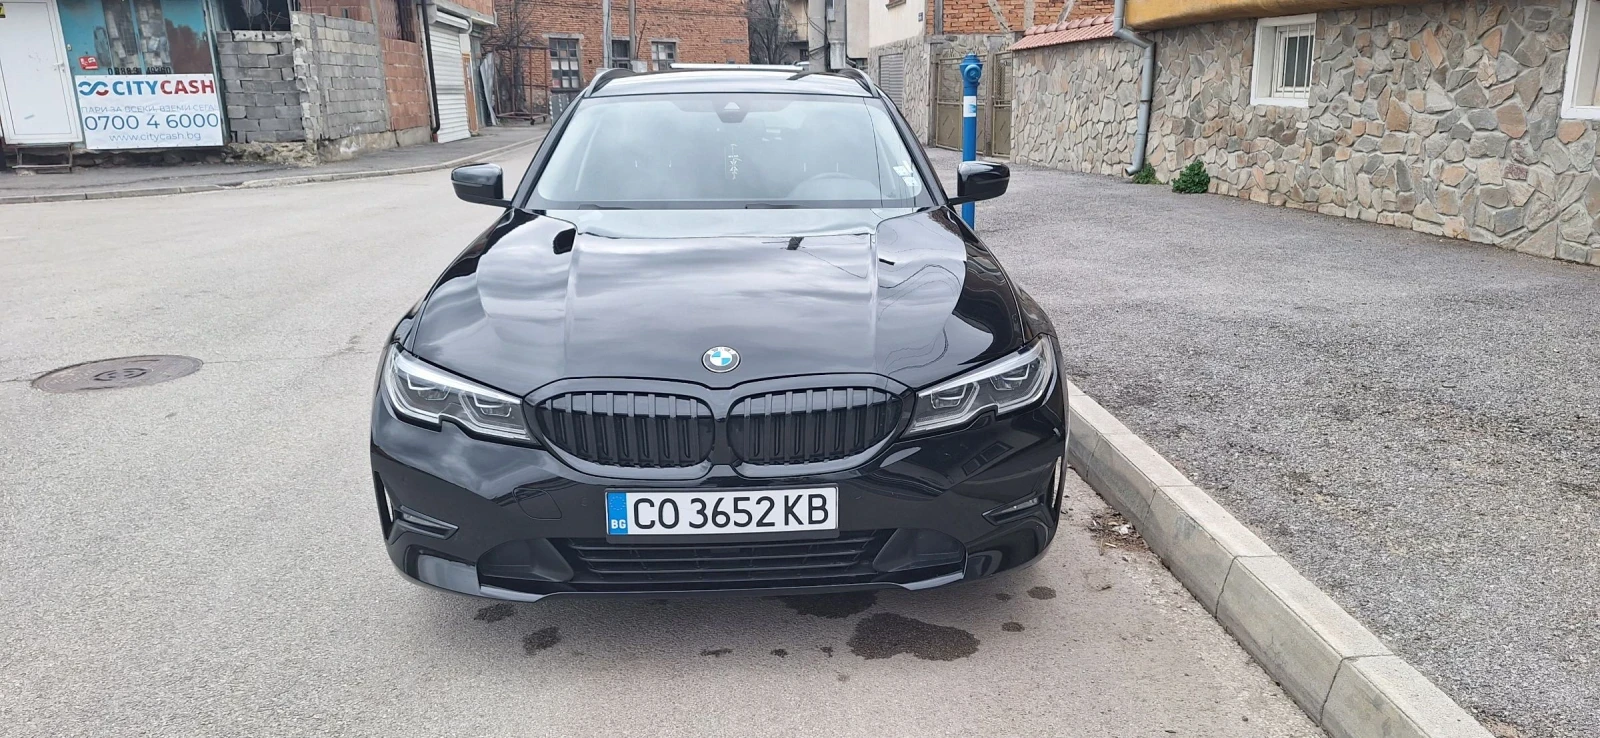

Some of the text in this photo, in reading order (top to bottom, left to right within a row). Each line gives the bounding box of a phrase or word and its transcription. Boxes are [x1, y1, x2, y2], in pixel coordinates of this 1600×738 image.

[84, 113, 219, 131] 0700 4 6000
[109, 131, 201, 143] www.citycash.bg
[688, 496, 775, 529] 3652
[783, 493, 829, 526] KB
[611, 519, 626, 529] BG
